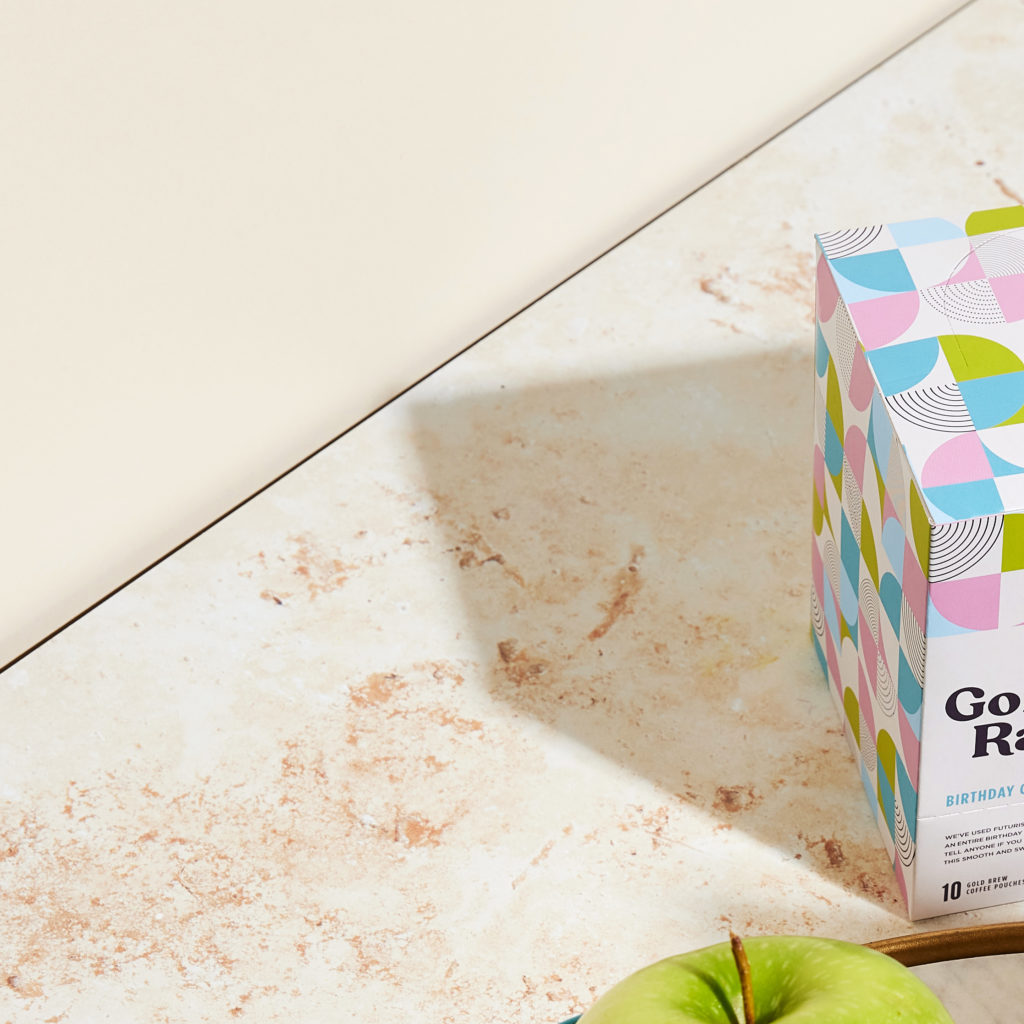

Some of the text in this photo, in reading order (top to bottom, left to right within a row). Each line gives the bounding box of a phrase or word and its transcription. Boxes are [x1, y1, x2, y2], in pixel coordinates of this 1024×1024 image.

[945, 784, 1015, 808] BIRTHDAY
[944, 831, 970, 841] WE'VE
[973, 827, 992, 836] USED
[957, 837, 985, 847] ENTIRE
[985, 830, 1023, 842] BIRTHDAY
[961, 851, 995, 862] SMOOTH
[995, 848, 1013, 856] AND
[963, 843, 996, 854] ANYONE
[966, 875, 1009, 888] GOLD BREW
[941, 880, 962, 902] 10
[966, 885, 991, 895] COFFEE
